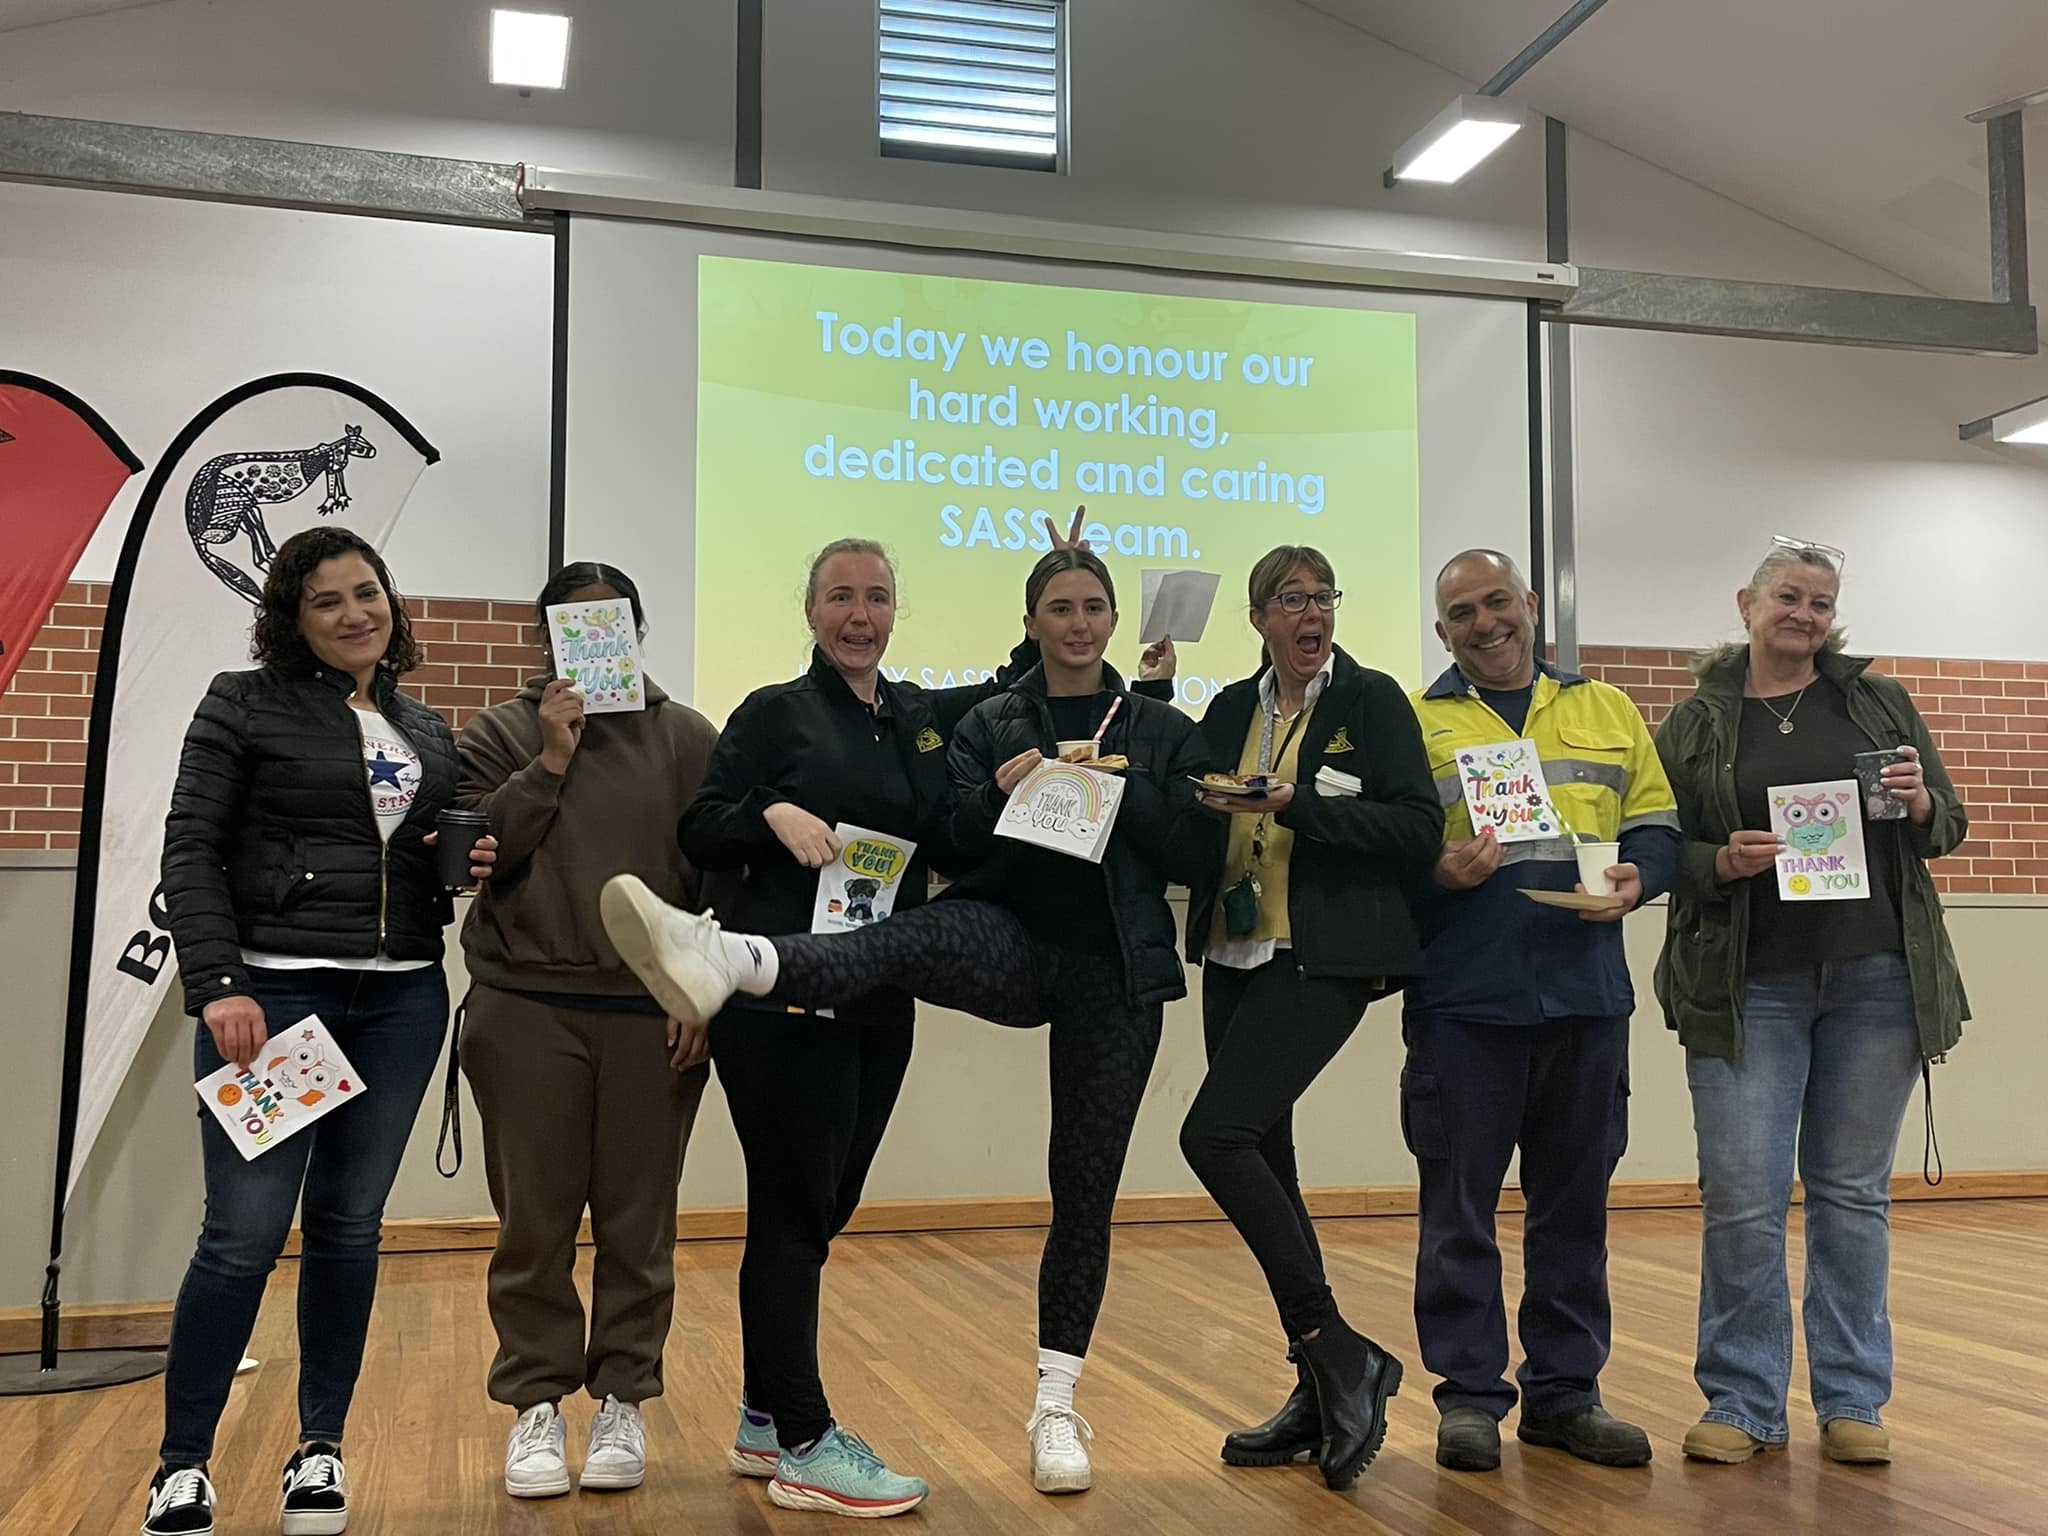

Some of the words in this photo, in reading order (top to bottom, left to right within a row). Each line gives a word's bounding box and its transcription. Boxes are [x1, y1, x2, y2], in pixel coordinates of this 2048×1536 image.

[815, 311, 966, 372] Today
[980, 334, 1050, 369] we
[1066, 330, 1228, 381] honour
[1242, 353, 1314, 387] our
[909, 378, 1017, 426] hard
[1033, 393, 1229, 449] working,
[804, 434, 1059, 491] dedicated
[1075, 455, 1165, 497] and
[1181, 460, 1325, 515] caring
[939, 504, 1053, 552] SASS
[1067, 511, 1201, 559] eam.
[561, 634, 629, 664] Thank
[577, 667, 625, 694] You
[1467, 774, 1535, 800] Thank
[1037, 793, 1077, 818] THANK
[1486, 803, 1533, 827] you
[1032, 809, 1069, 833] YOU
[1781, 856, 1846, 873] THANK
[1821, 873, 1860, 890] YOU
[240, 1107, 273, 1145] YOU
